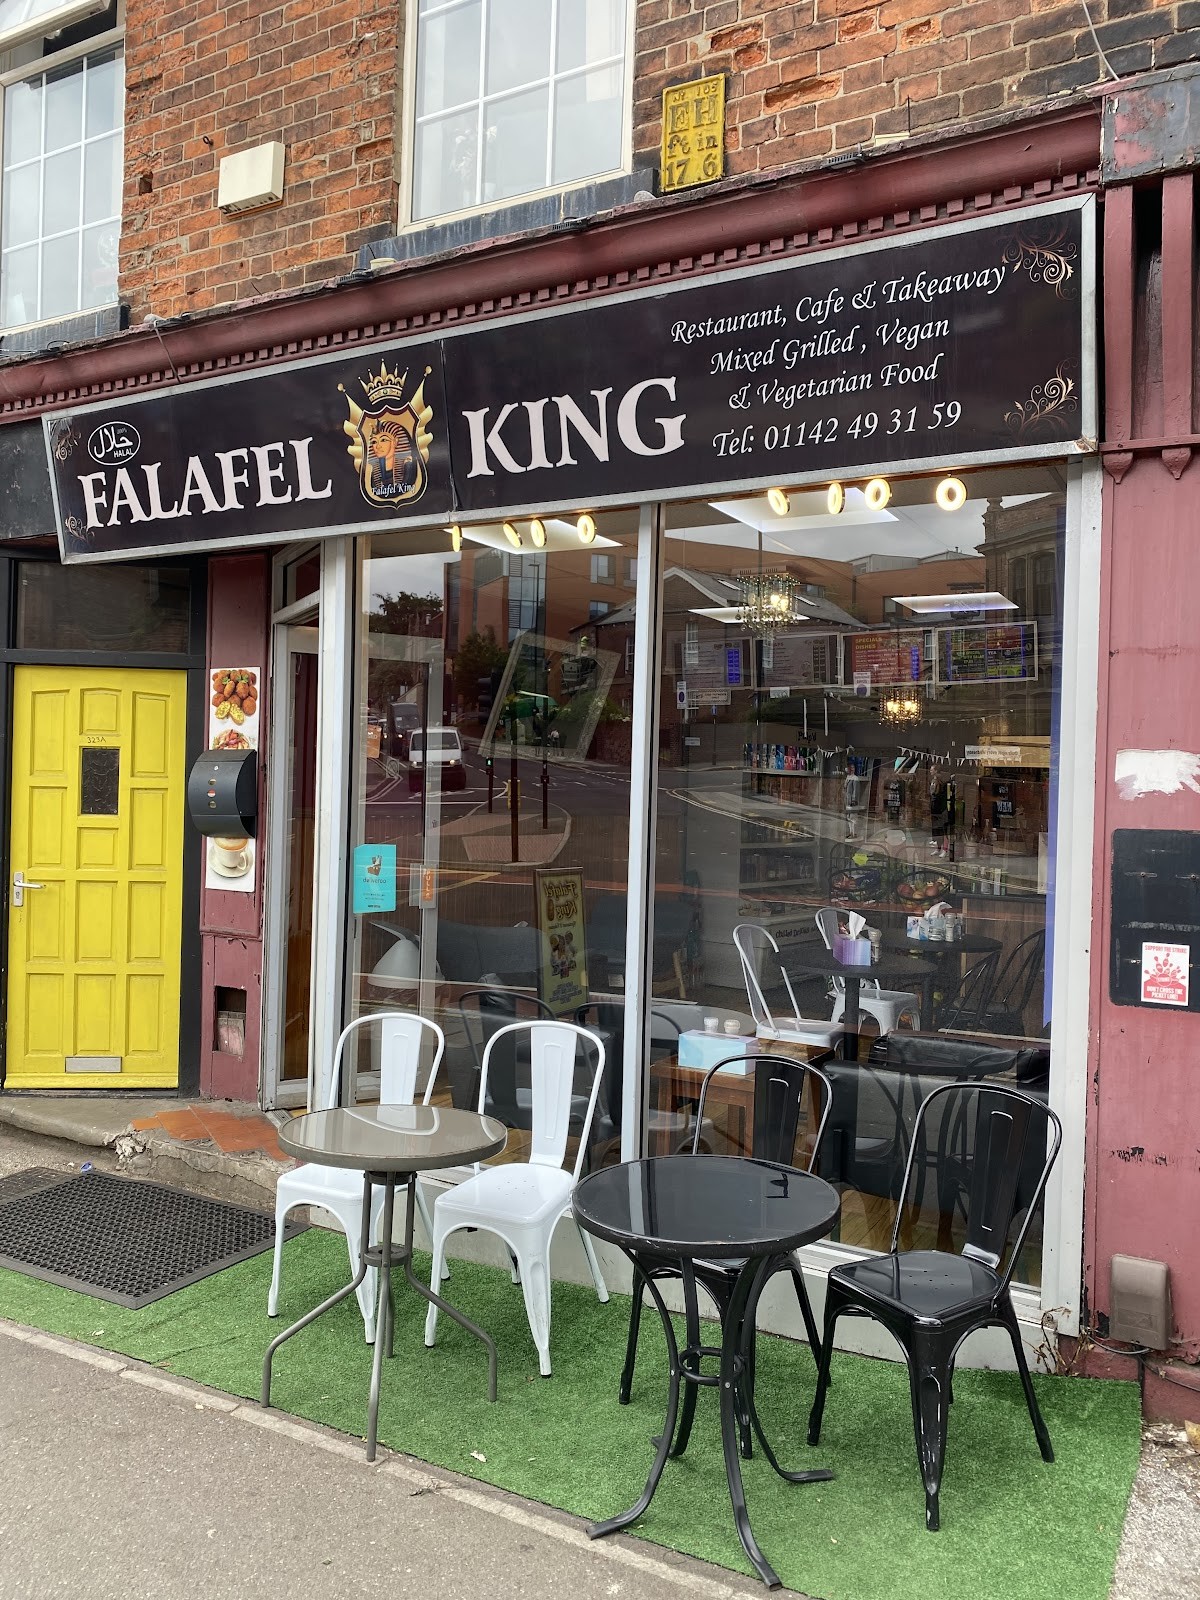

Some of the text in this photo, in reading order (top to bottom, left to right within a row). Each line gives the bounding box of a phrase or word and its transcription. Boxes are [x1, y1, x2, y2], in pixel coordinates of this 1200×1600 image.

[666, 153, 717, 187] 17 6
[671, 264, 1006, 344] Restaurant, Cafe & Takeaway
[710, 339, 781, 376] Mixed
[782, 326, 857, 370] Grilled
[875, 315, 950, 354] Vegan
[729, 353, 945, 410] & Vegetarian Food
[77, 376, 687, 529] FALAFEL KING
[113, 447, 134, 458] HALAL
[712, 400, 963, 459] Tel: 01142 49 31 59
[372, 482, 415, 498] Falafel King
